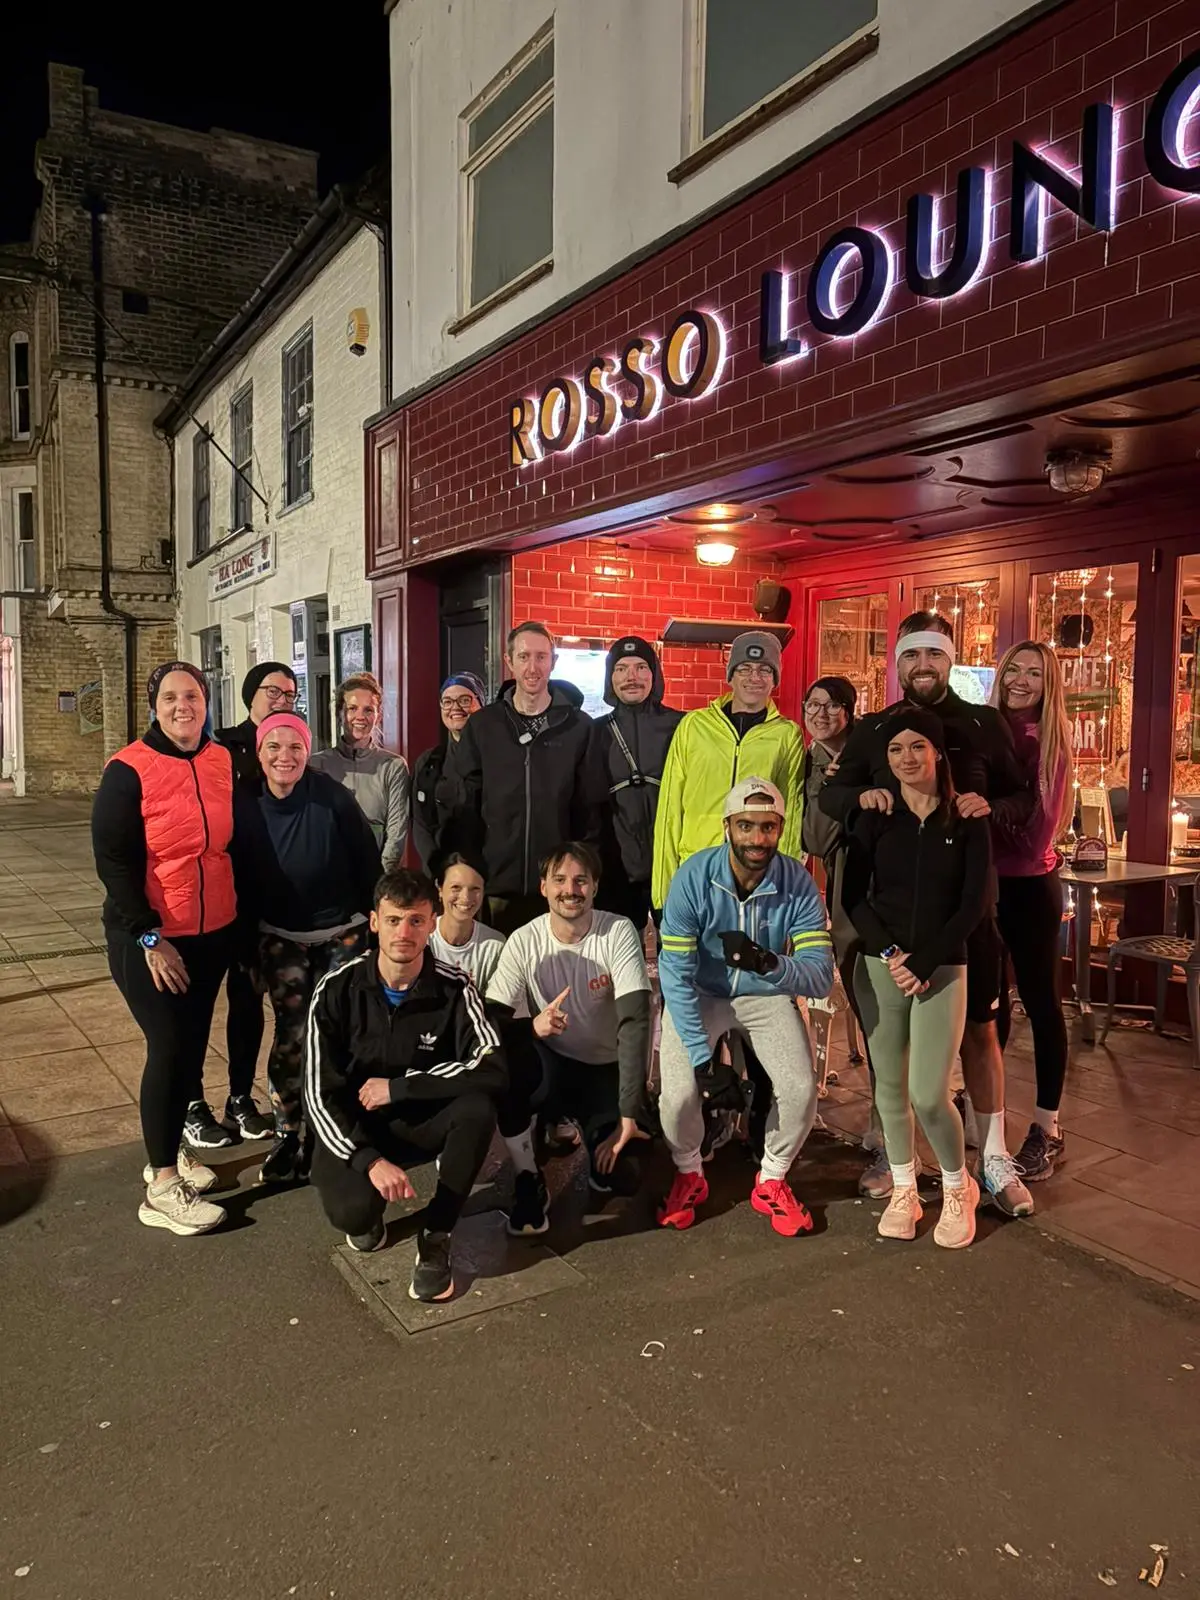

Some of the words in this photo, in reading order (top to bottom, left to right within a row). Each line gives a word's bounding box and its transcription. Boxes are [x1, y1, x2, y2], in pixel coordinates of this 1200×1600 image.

[509, 310, 728, 467] ROSSO
[232, 551, 255, 576] LONG
[1061, 658, 1102, 687] CAFE
